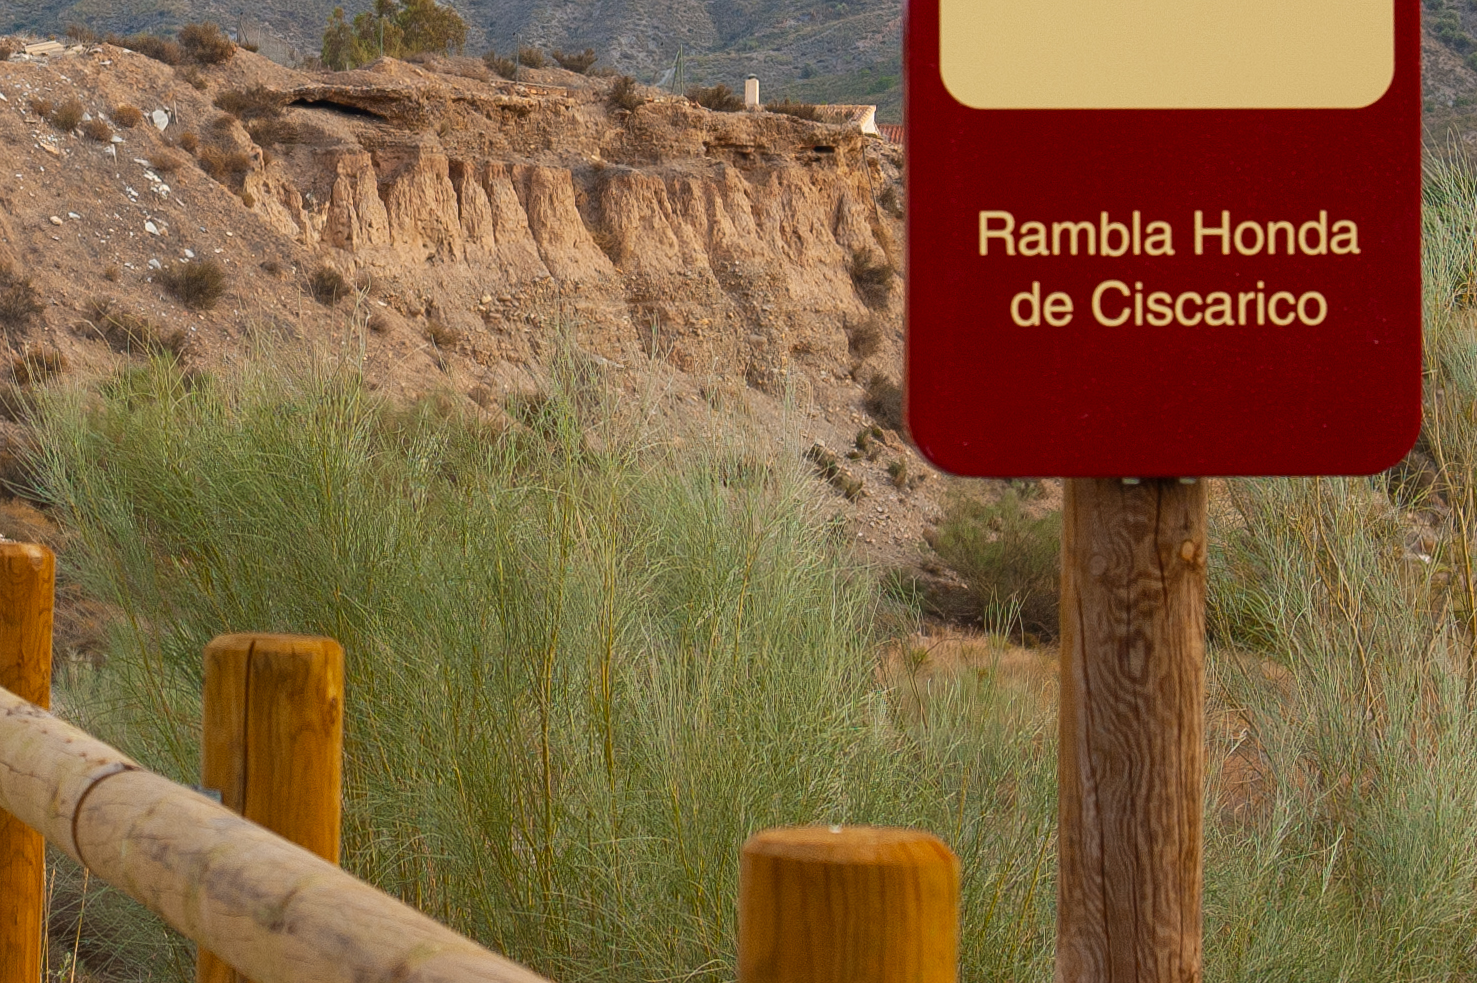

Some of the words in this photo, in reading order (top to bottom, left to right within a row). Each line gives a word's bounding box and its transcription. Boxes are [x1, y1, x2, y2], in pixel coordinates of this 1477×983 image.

[979, 210, 1175, 257] Rambla
[1195, 210, 1360, 256] Honda
[1011, 281, 1073, 326] de
[1092, 280, 1327, 326] Ciscarico
